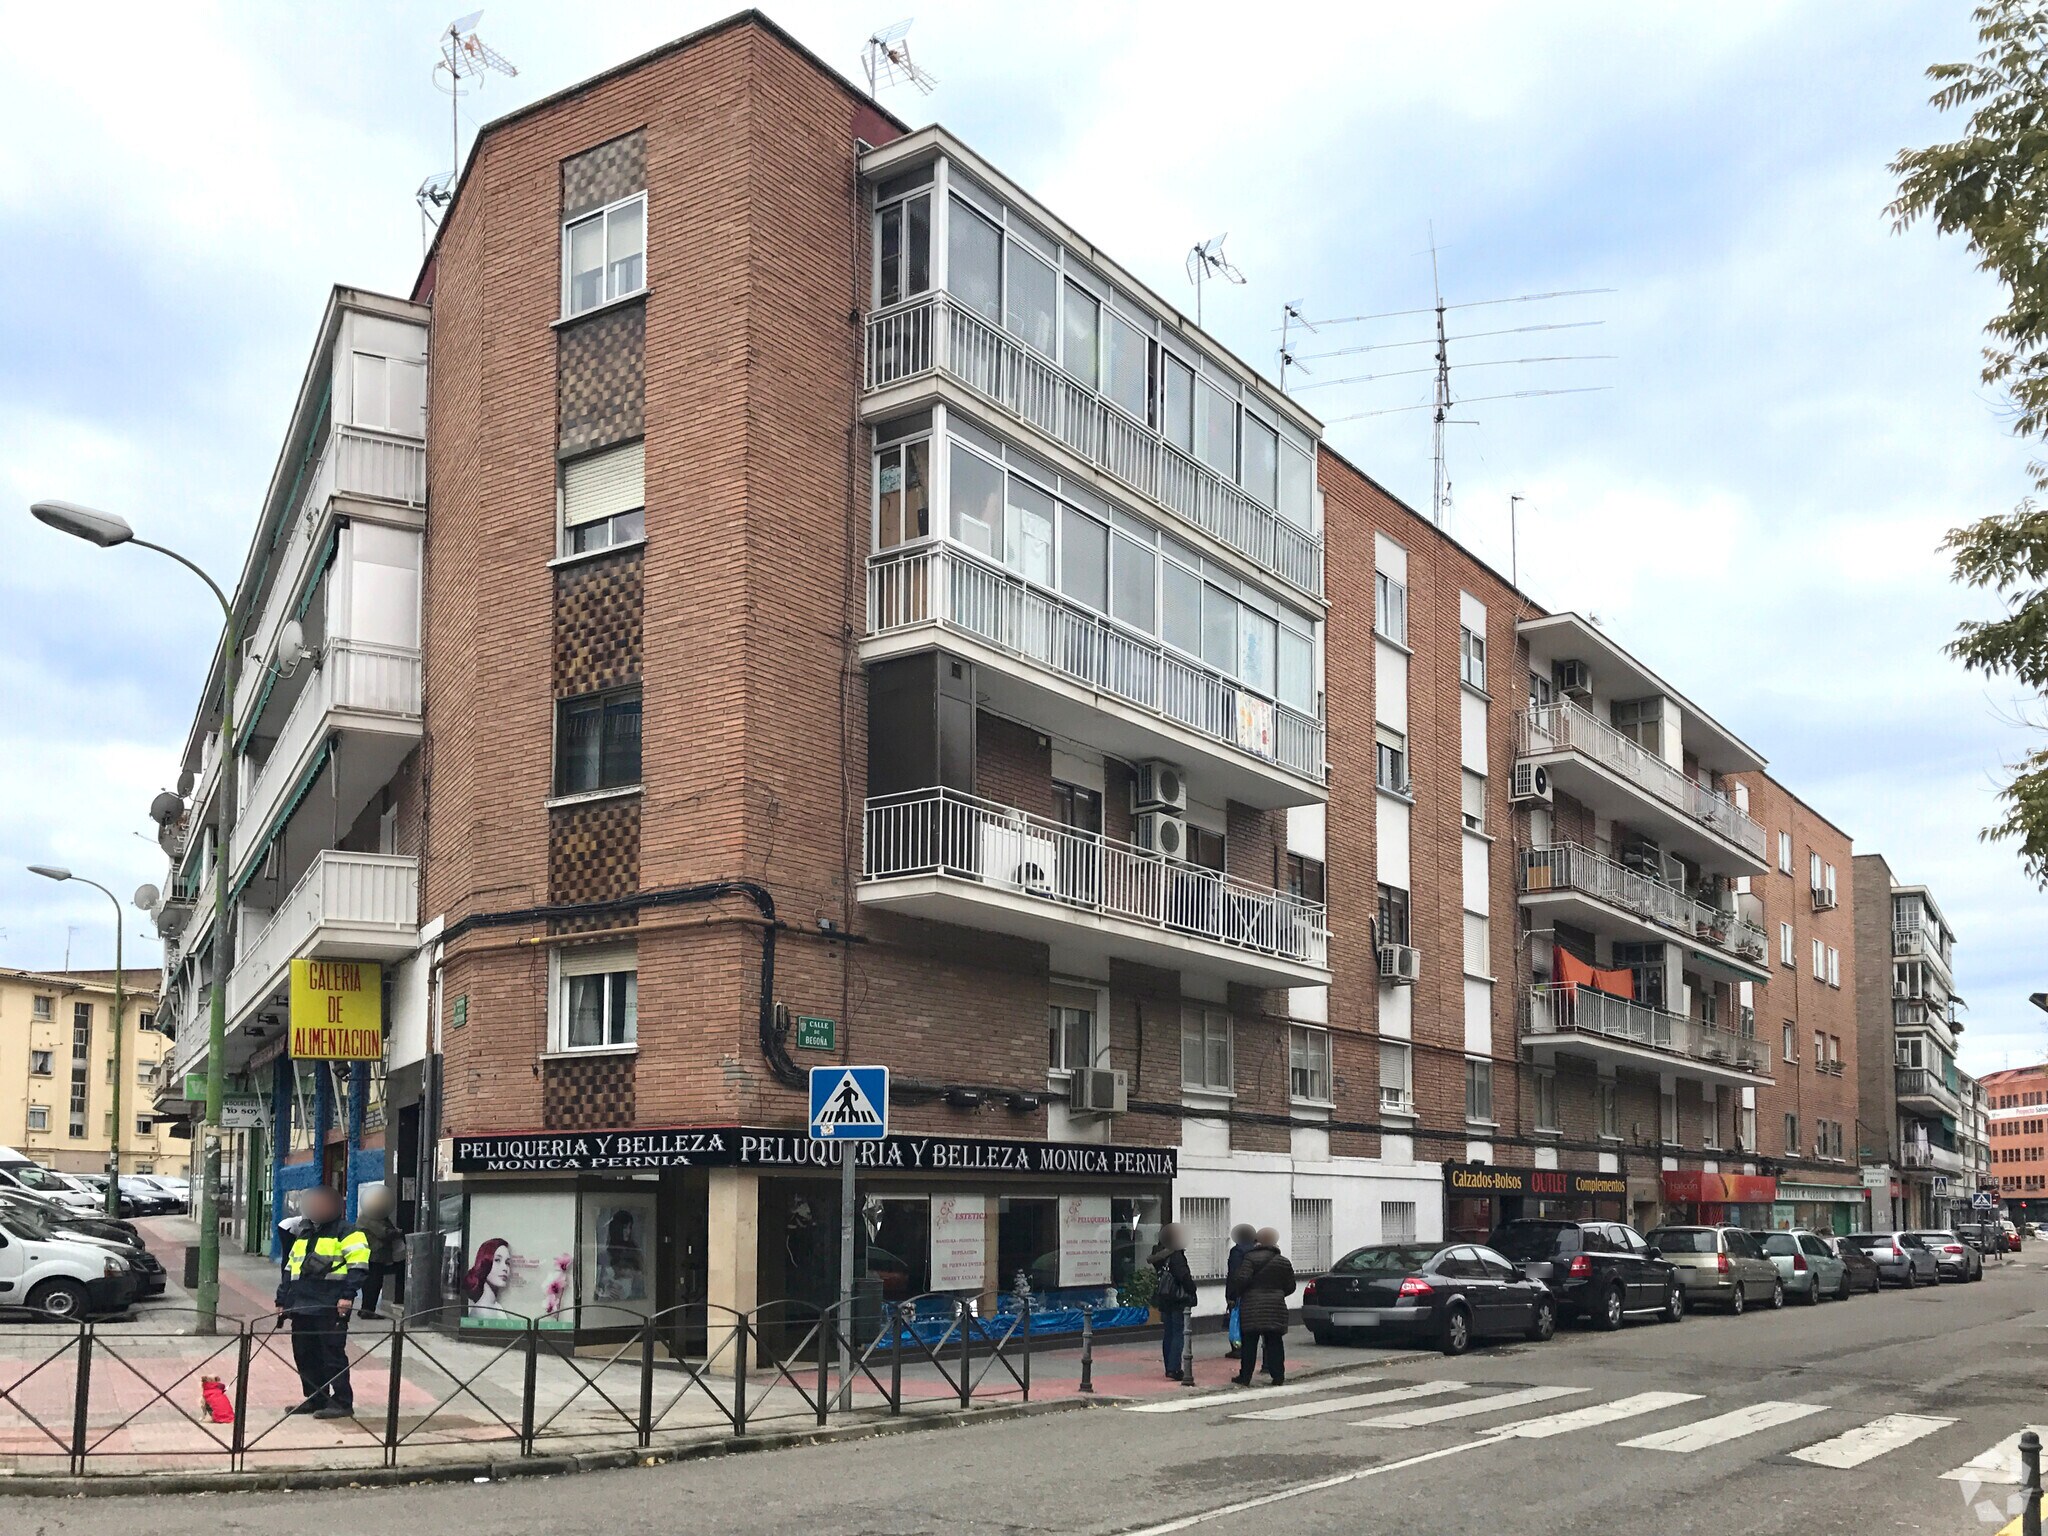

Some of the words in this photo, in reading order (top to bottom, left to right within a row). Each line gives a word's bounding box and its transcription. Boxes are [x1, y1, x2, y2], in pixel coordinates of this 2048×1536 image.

[309, 962, 362, 992] GALERIA
[327, 995, 344, 1024] DE
[809, 1020, 829, 1030] CALLE
[293, 1027, 380, 1057] ALIMENTACION
[805, 1035, 828, 1047] BEGOÑA
[459, 1138, 591, 1160] PELUQUERIA
[596, 1134, 614, 1157] Y
[616, 1132, 727, 1155] BELLEZA
[910, 1138, 929, 1169] Y
[932, 1144, 1032, 1170] BELLEZA
[1038, 1148, 1110, 1173] MONICA
[1113, 1151, 1175, 1175] PERNIA
[486, 1156, 583, 1171] MONICA
[590, 1154, 693, 1169] PERNIA
[1452, 1170, 1522, 1190] Calzados-Bolsos
[1530, 1171, 1568, 1194] OUTLET
[1575, 1175, 1626, 1195] Complementos
[954, 1212, 988, 1221] ESTETICA
